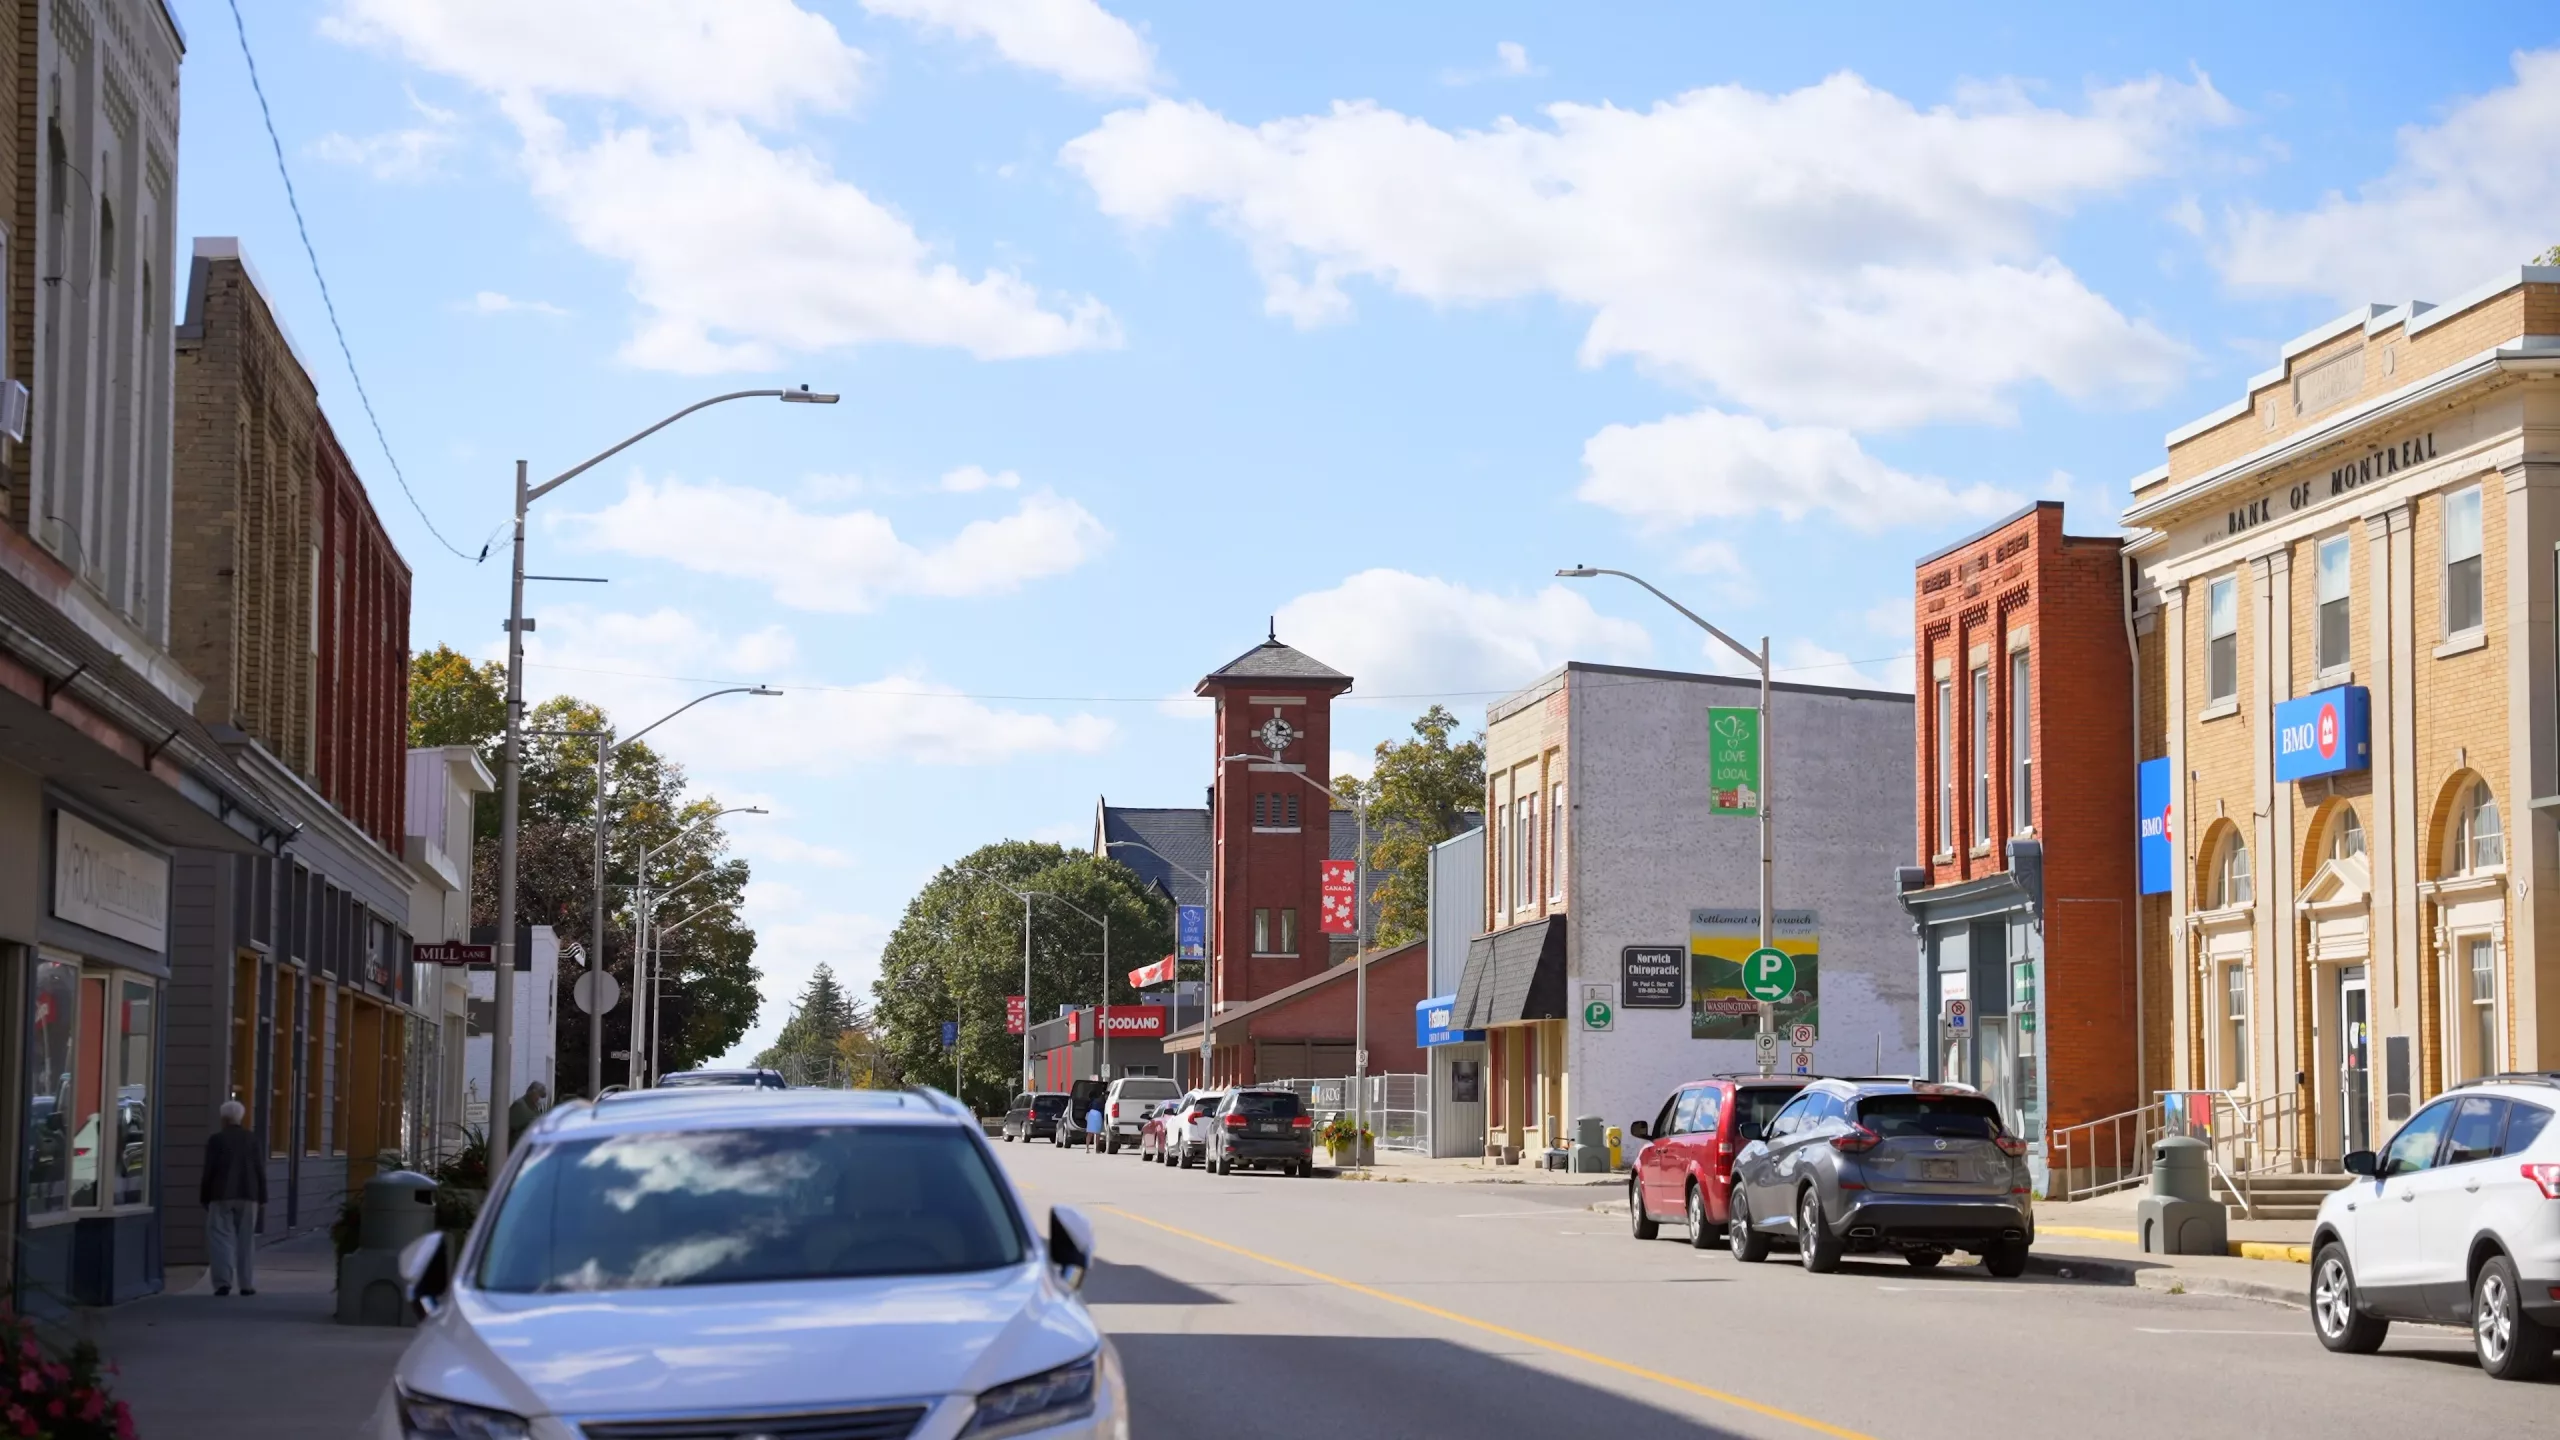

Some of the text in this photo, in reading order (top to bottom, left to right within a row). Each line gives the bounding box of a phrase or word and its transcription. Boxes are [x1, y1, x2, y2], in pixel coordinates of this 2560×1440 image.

[2228, 432, 2437, 535] BANK OF MONTREAL
[2281, 722, 2315, 755] BMO
[1718, 750, 1747, 763] LOVE
[1717, 768, 1751, 781] LOCAL
[2141, 816, 2162, 838] BMO
[1696, 914, 1748, 924] Settlement
[1771, 915, 1812, 925] orwich
[1184, 926, 1199, 934] LOVE
[420, 947, 459, 960] MILL
[1636, 953, 1671, 964] Norwich
[1628, 965, 1680, 977] Chiropractic
[1760, 955, 1782, 981] P
[1592, 1005, 1605, 1020] P
[1706, 1001, 1752, 1011] WASHINGTON
